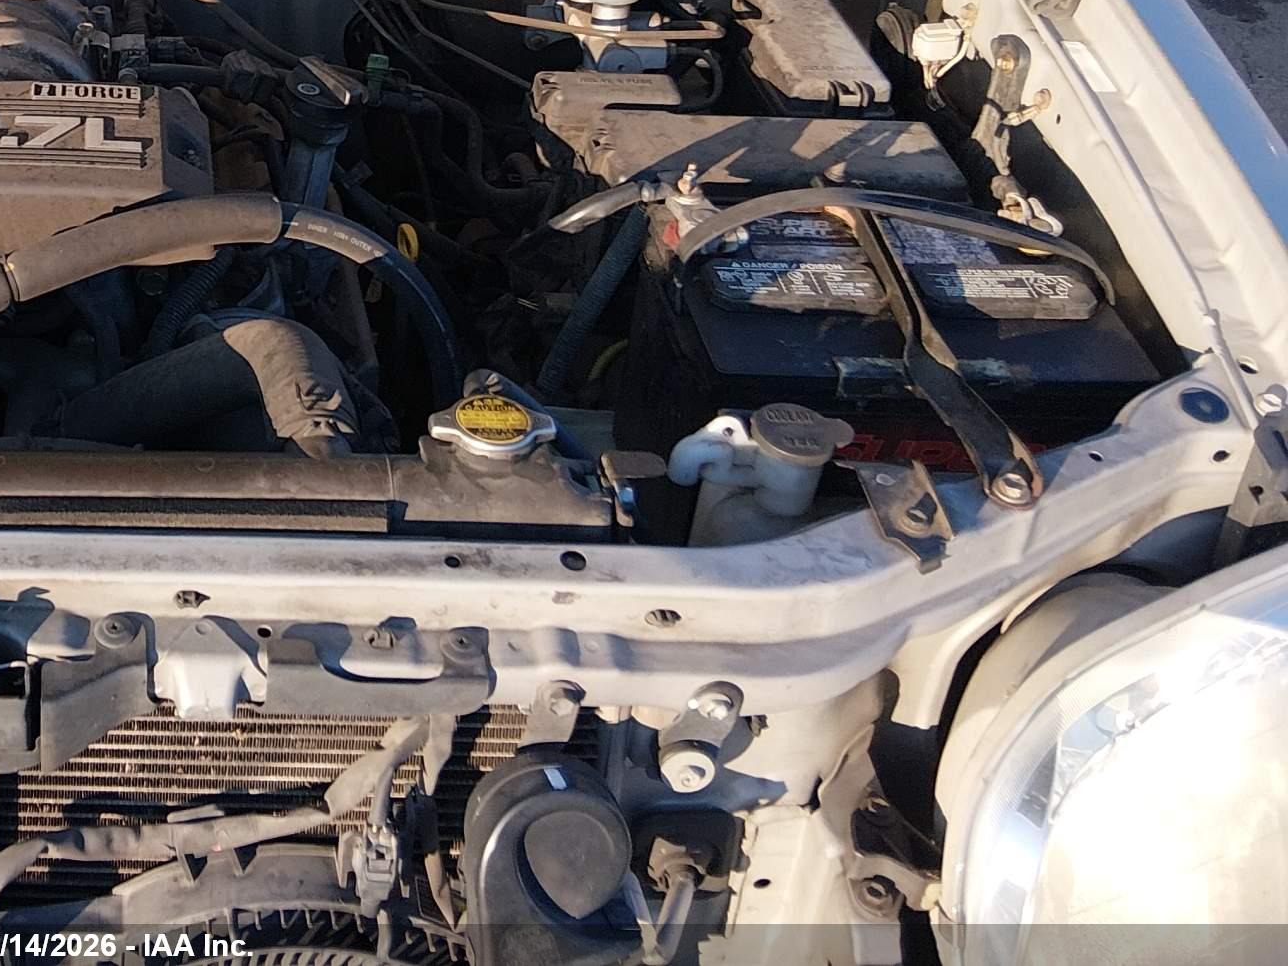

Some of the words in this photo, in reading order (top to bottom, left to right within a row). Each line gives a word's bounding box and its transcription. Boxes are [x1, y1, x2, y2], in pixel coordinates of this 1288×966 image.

[756, 217, 830, 228] SUPER
[750, 225, 833, 236] START
[741, 261, 789, 270] DANGER
[799, 262, 843, 271] POISON
